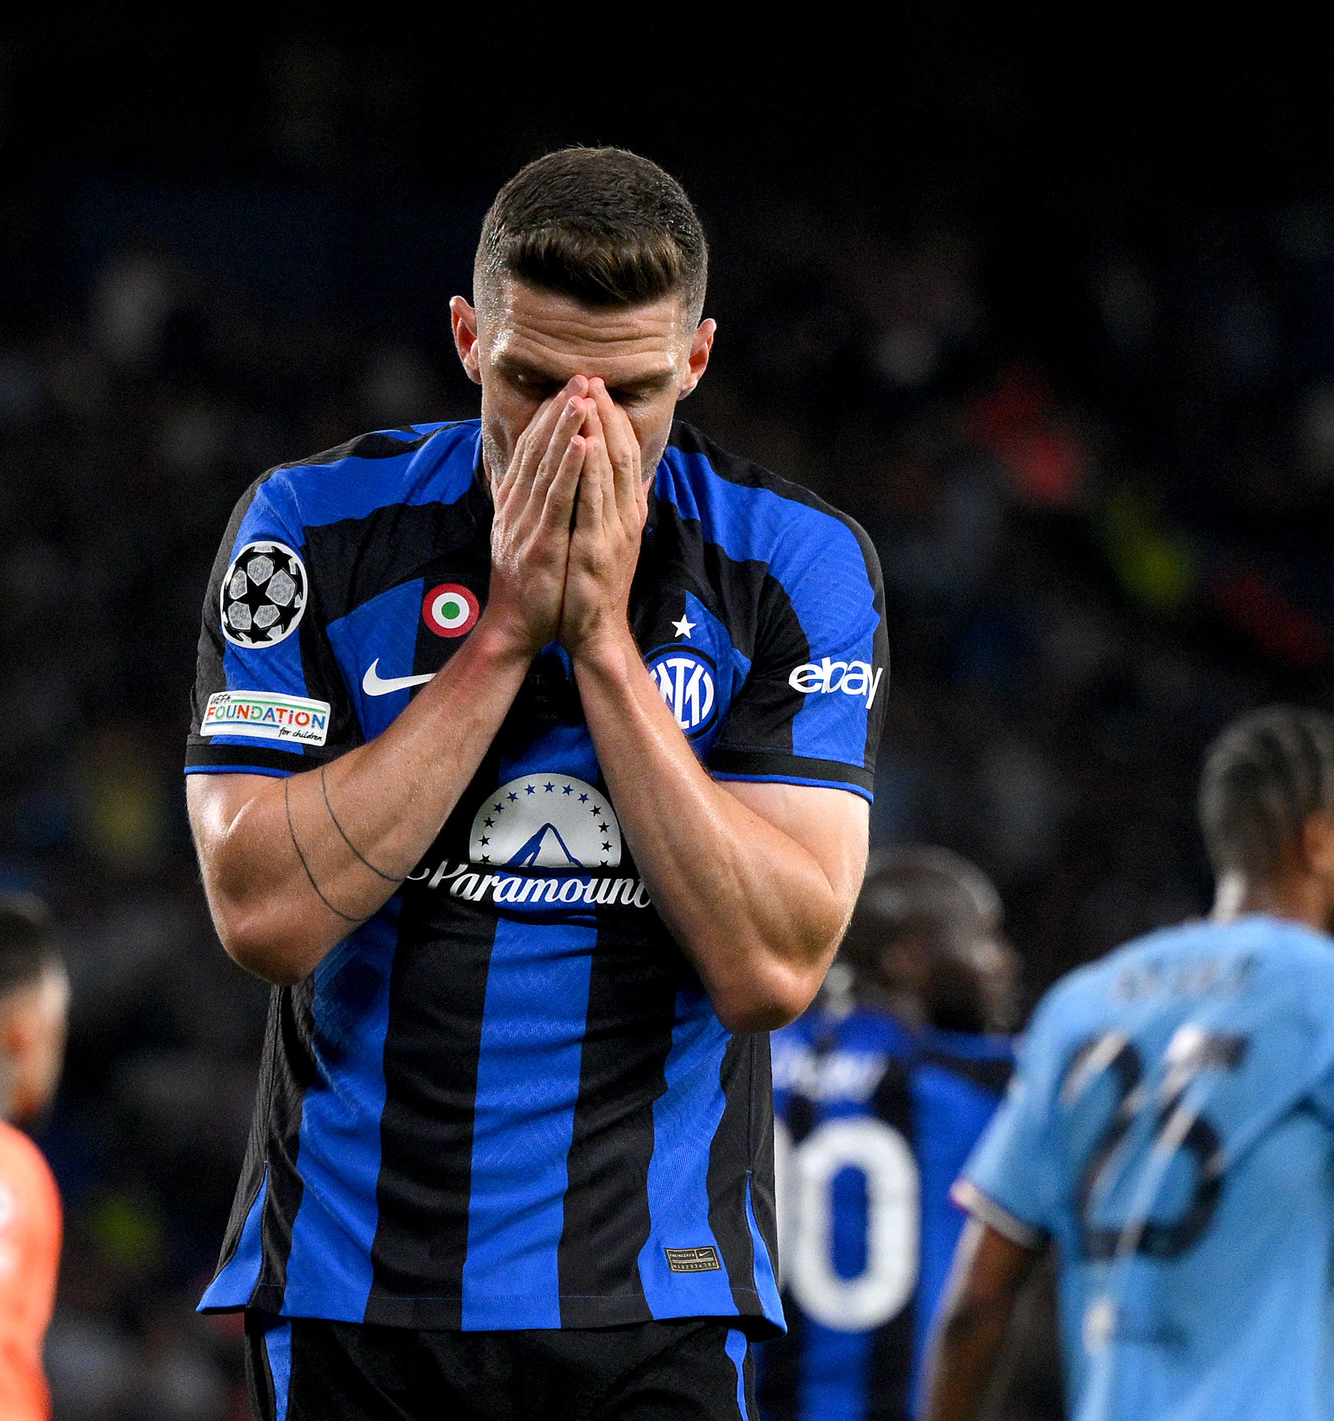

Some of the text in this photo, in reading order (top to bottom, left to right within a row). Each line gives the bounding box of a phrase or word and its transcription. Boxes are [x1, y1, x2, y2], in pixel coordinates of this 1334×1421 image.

[788, 656, 883, 710] ebay
[210, 694, 231, 705] UEFA
[206, 704, 326, 730] FOUNDATION
[278, 727, 323, 742] for children
[1061, 1029, 1251, 1264] 25
